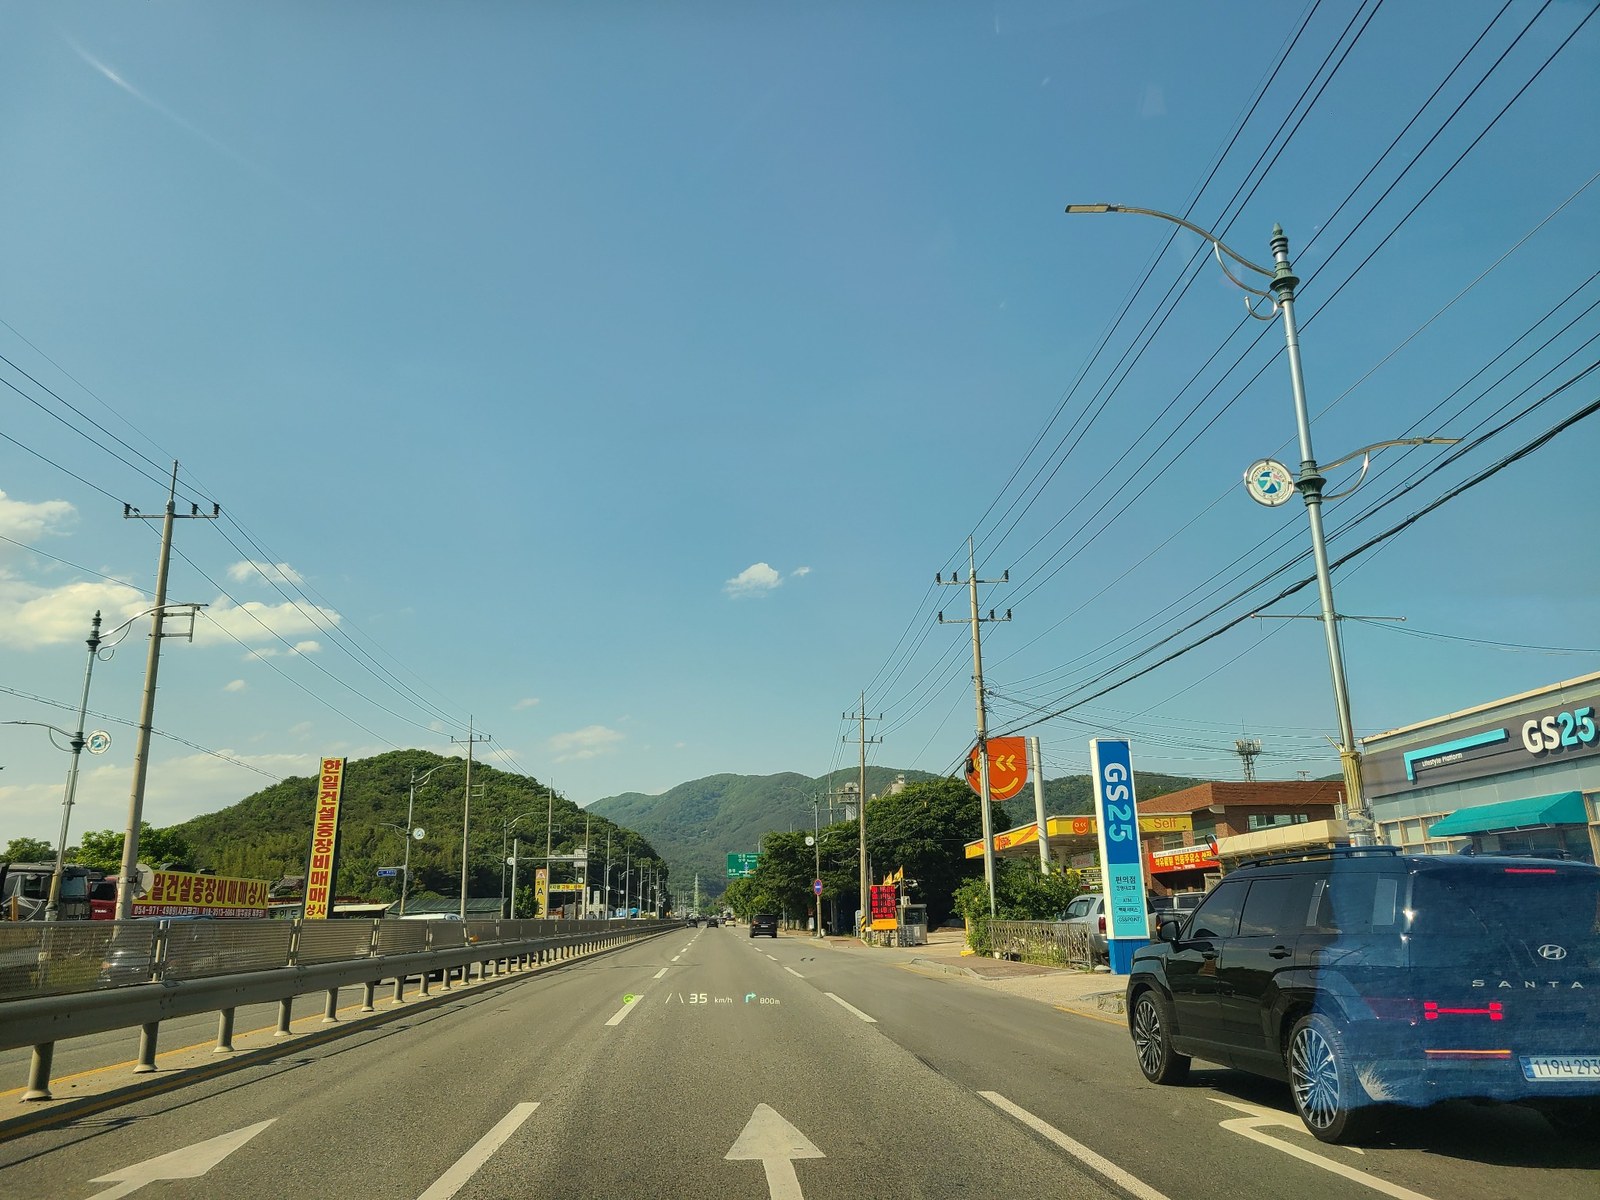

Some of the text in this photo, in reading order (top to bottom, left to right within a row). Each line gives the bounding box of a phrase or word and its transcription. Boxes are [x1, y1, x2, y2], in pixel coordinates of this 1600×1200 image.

[1522, 706, 1596, 753] GS25
[1421, 752, 1463, 767] Lifestyle Platform
[1104, 763, 1133, 842] GS25
[1154, 817, 1177, 829] Self
[1115, 875, 1136, 884] 편의점
[138, 872, 268, 905] 일건설중장비매매상사
[1472, 979, 1584, 989] SANTA
[689, 993, 781, 1005] 35 km/h 800m
[1574, 1059, 1600, 1075] 293
